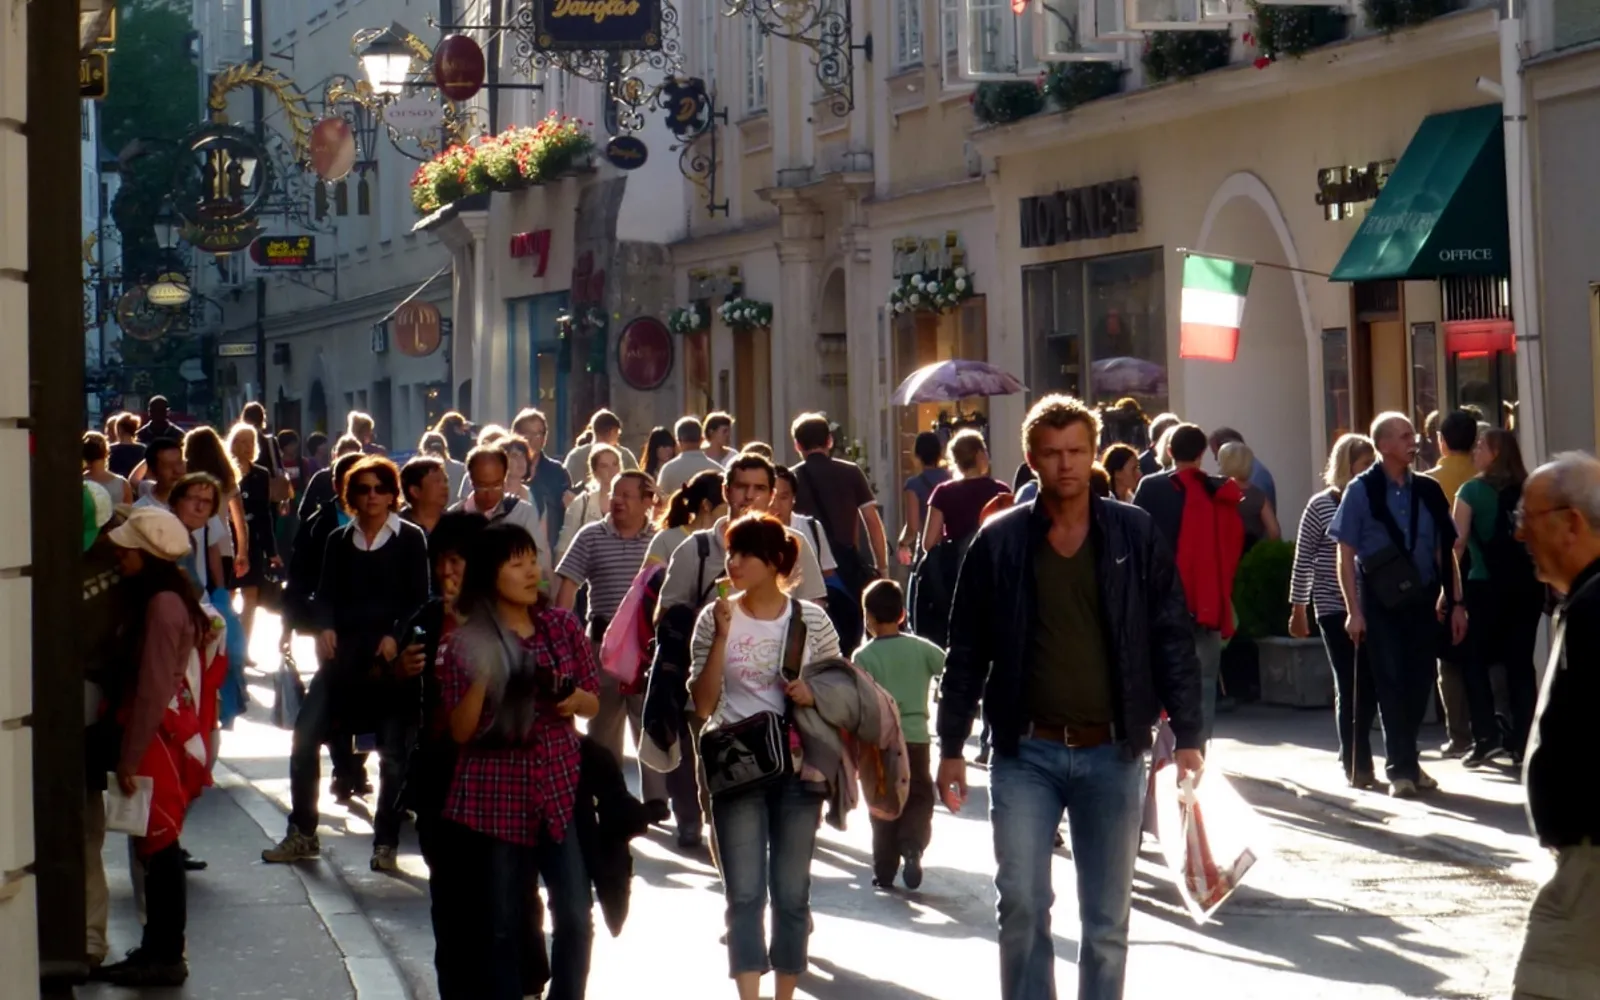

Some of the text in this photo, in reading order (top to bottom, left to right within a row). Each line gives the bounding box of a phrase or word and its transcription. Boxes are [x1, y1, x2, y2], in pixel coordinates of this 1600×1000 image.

[551, 0, 640, 23] Douglas
[389, 109, 437, 119] orsay
[1438, 248, 1493, 261] OFFICE
